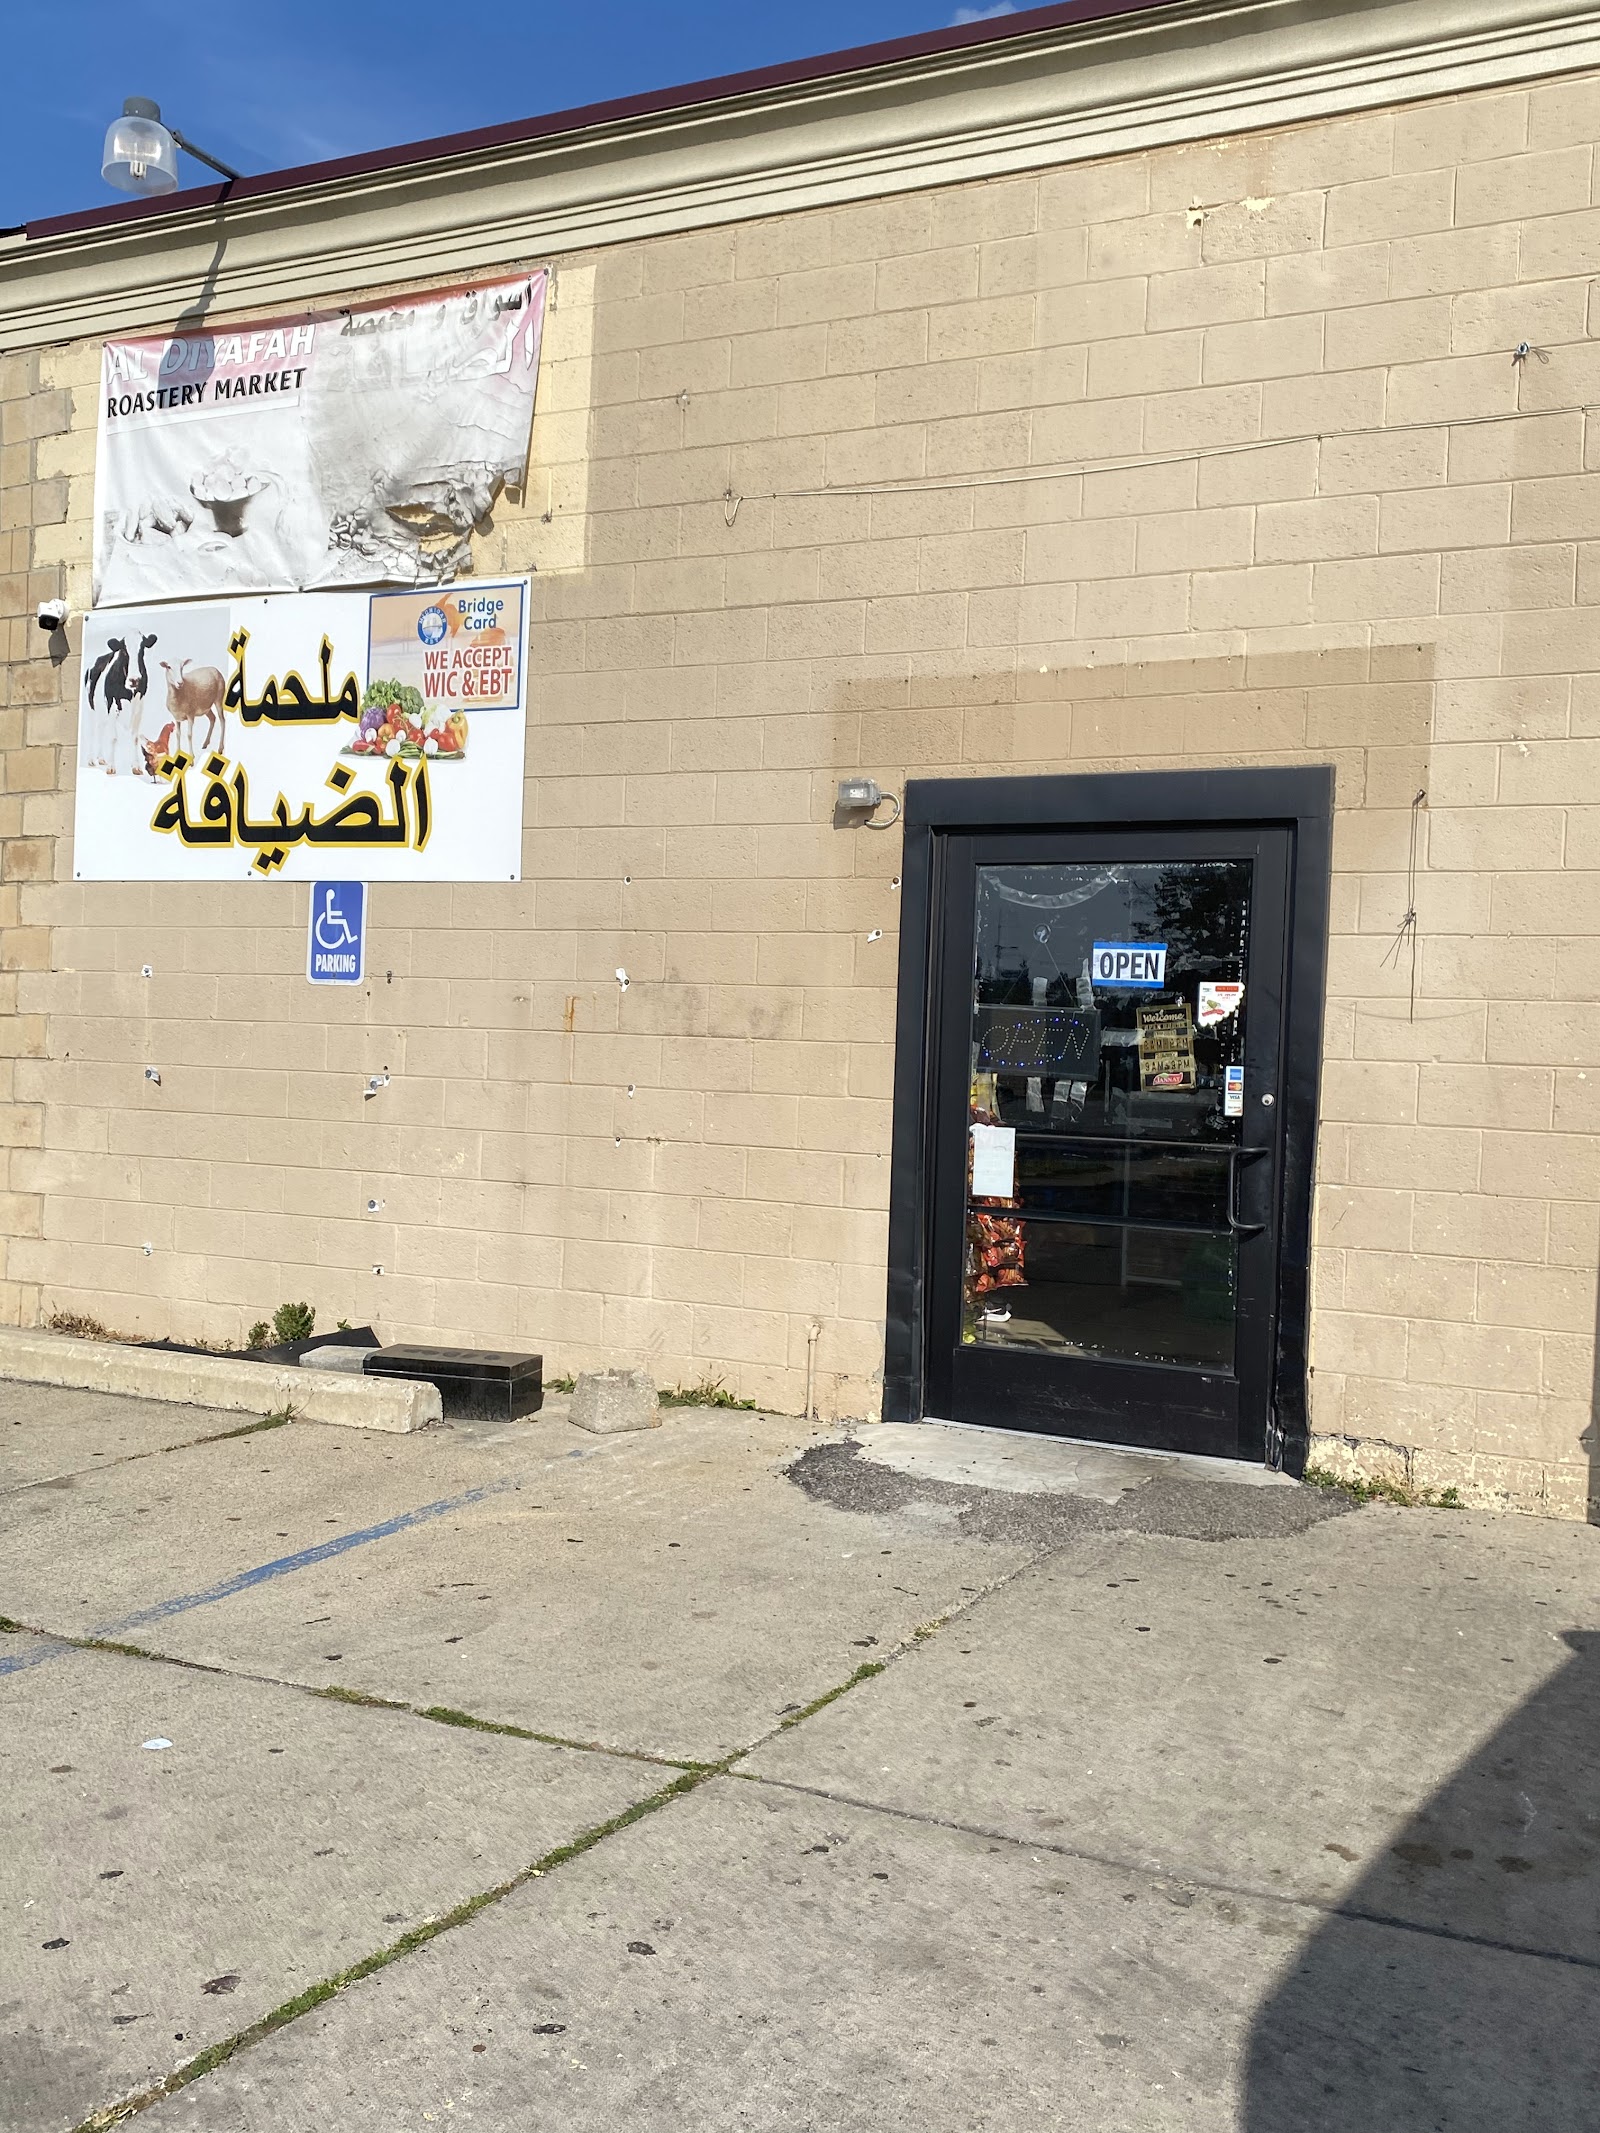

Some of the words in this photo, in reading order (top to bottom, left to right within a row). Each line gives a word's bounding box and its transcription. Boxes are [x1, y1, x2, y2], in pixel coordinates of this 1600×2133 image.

[107, 345, 149, 385] AL
[159, 324, 317, 376] DIYAFAH
[107, 382, 208, 418] ROASTERY
[215, 367, 307, 401] MARKET
[458, 597, 504, 615] Bridge
[464, 614, 497, 630] Card
[425, 650, 449, 670] WE
[452, 646, 513, 669] ACCEPT
[223, 626, 361, 727] ملحمة
[424, 671, 457, 698] WIC
[462, 670, 475, 697] &
[479, 668, 512, 696] EBT
[150, 749, 432, 876] الضيافة
[315, 953, 356, 973] PARKING
[1100, 951, 1160, 979] OPEN
[1142, 1009, 1186, 1023] Welcome
[982, 1025, 1091, 1060] OPEN
